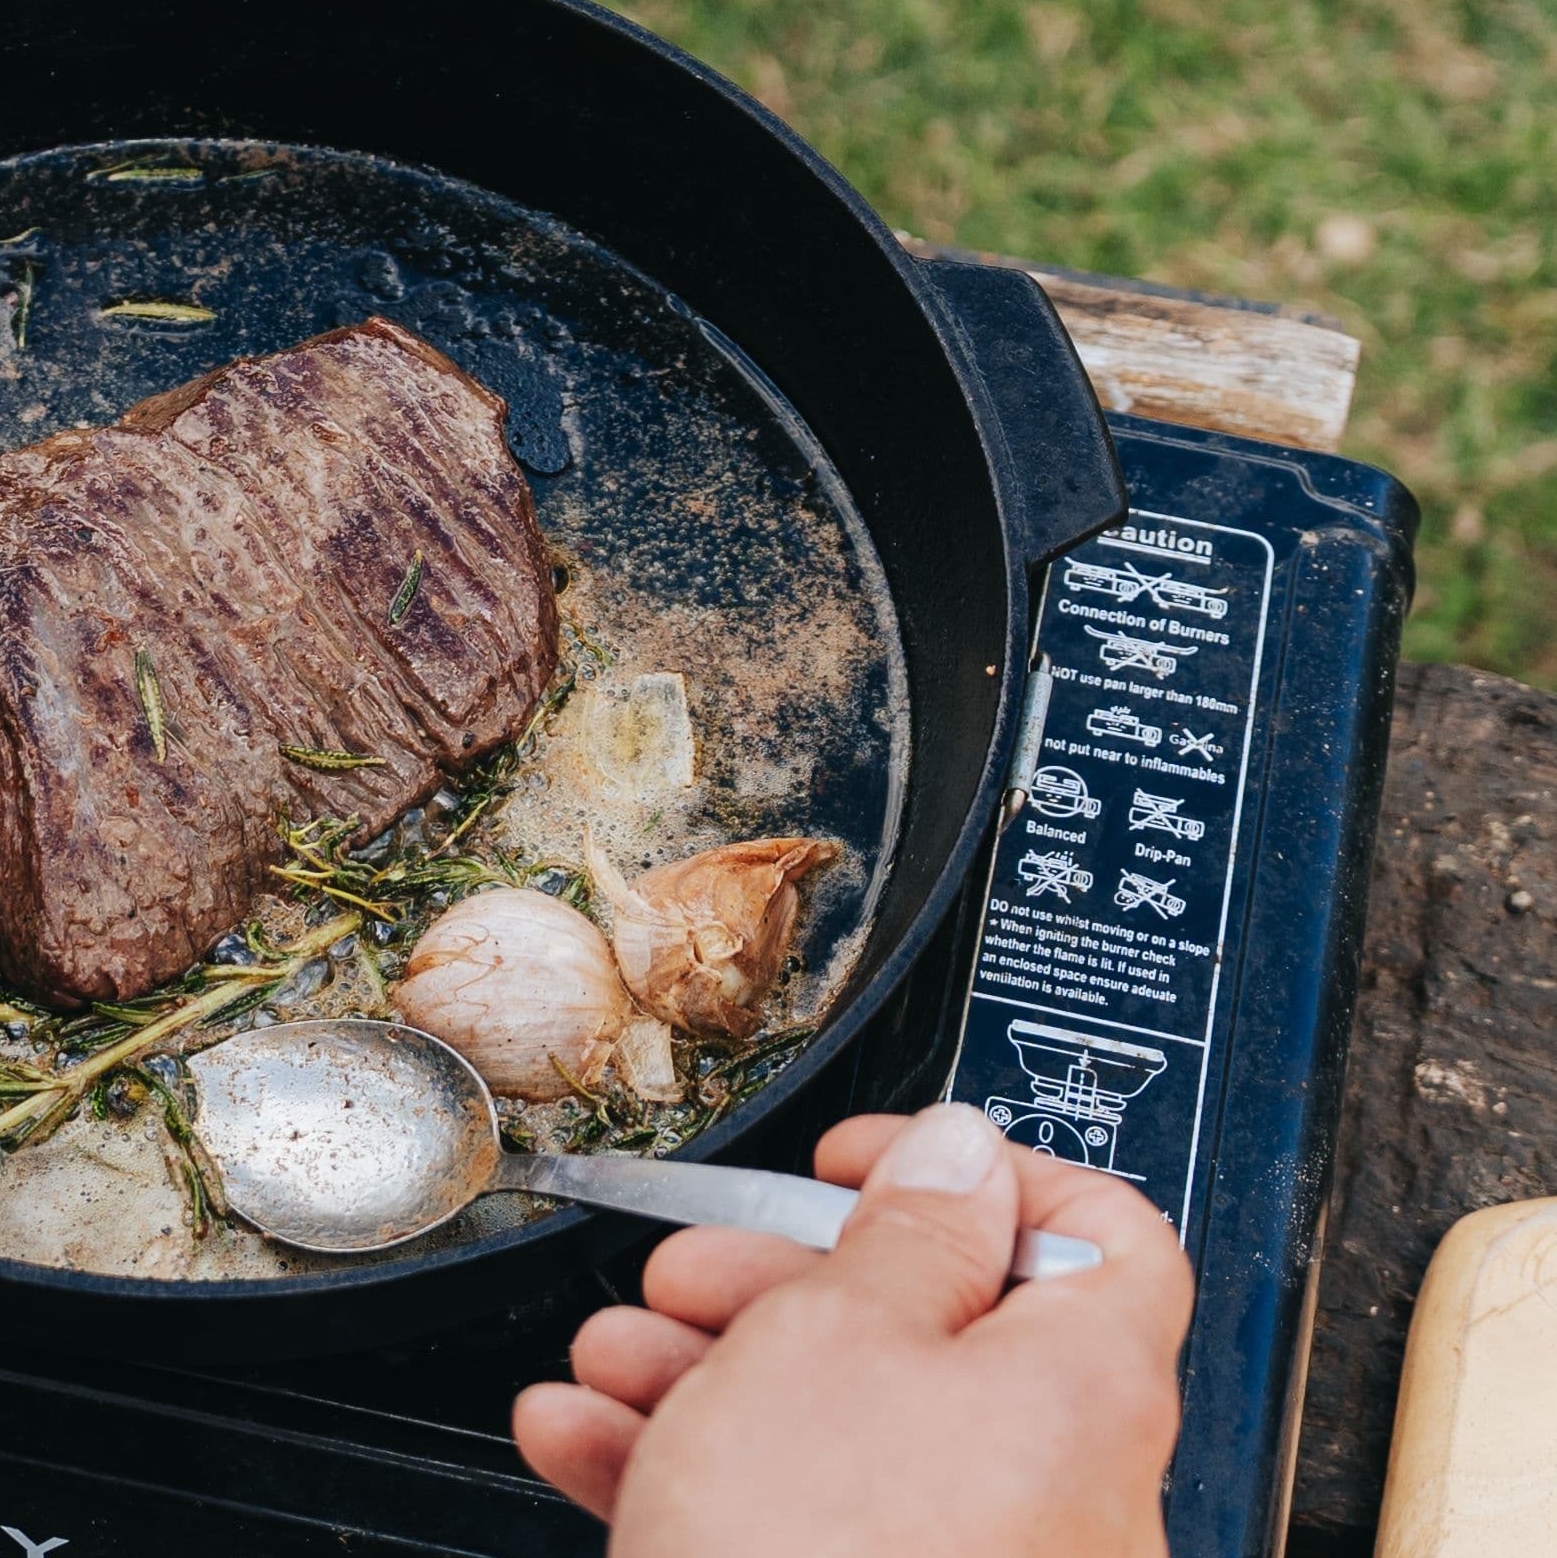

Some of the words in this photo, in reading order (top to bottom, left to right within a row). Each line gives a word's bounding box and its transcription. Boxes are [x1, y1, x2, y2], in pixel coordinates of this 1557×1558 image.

[1058, 599, 1146, 627] Connection
[1149, 619, 1166, 631] of
[1168, 620, 1229, 645] Burners
[1080, 675, 1102, 686] use
[1104, 679, 1126, 690] pan
[1129, 681, 1164, 699] larger
[1166, 690, 1193, 704] than
[1196, 695, 1238, 714] 180mm
[1045, 737, 1066, 750] not
[1068, 743, 1090, 755] put
[1094, 748, 1122, 761] near
[1125, 753, 1138, 765] to
[1141, 755, 1225, 784] inflammables
[1026, 820, 1086, 844] Balanced
[1135, 843, 1190, 867] Drip-Pan
[990, 899, 1008, 912] DO
[1011, 906, 1030, 917] not
[1032, 910, 1052, 921] use
[1056, 915, 1089, 929] whilst
[1092, 923, 1134, 942] moving
[1136, 932, 1149, 941] or
[1152, 935, 1166, 946] on
[1169, 939, 1176, 948] a
[1178, 940, 1210, 956] slope
[1000, 919, 1032, 934] When
[1035, 925, 1078, 947] igniting
[1081, 936, 1099, 949] the
[1102, 940, 1140, 957] burner
[1142, 950, 1175, 966] check
[982, 953, 996, 963] an
[999, 956, 1051, 975] enclosed
[1053, 968, 1087, 983] space
[1090, 976, 1129, 992] ensure
[1131, 985, 1176, 1003] adeuate
[984, 934, 1031, 952] whether
[1033, 944, 1051, 957] the
[1054, 947, 1085, 964] flame
[1088, 955, 1098, 967] is
[1101, 957, 1114, 971] lit.
[1118, 961, 1126, 973] If
[1128, 966, 1156, 980] used
[1158, 970, 1169, 983] in
[980, 968, 1039, 990] ventilation
[1042, 981, 1052, 993] is
[1055, 986, 1108, 1005] available.
